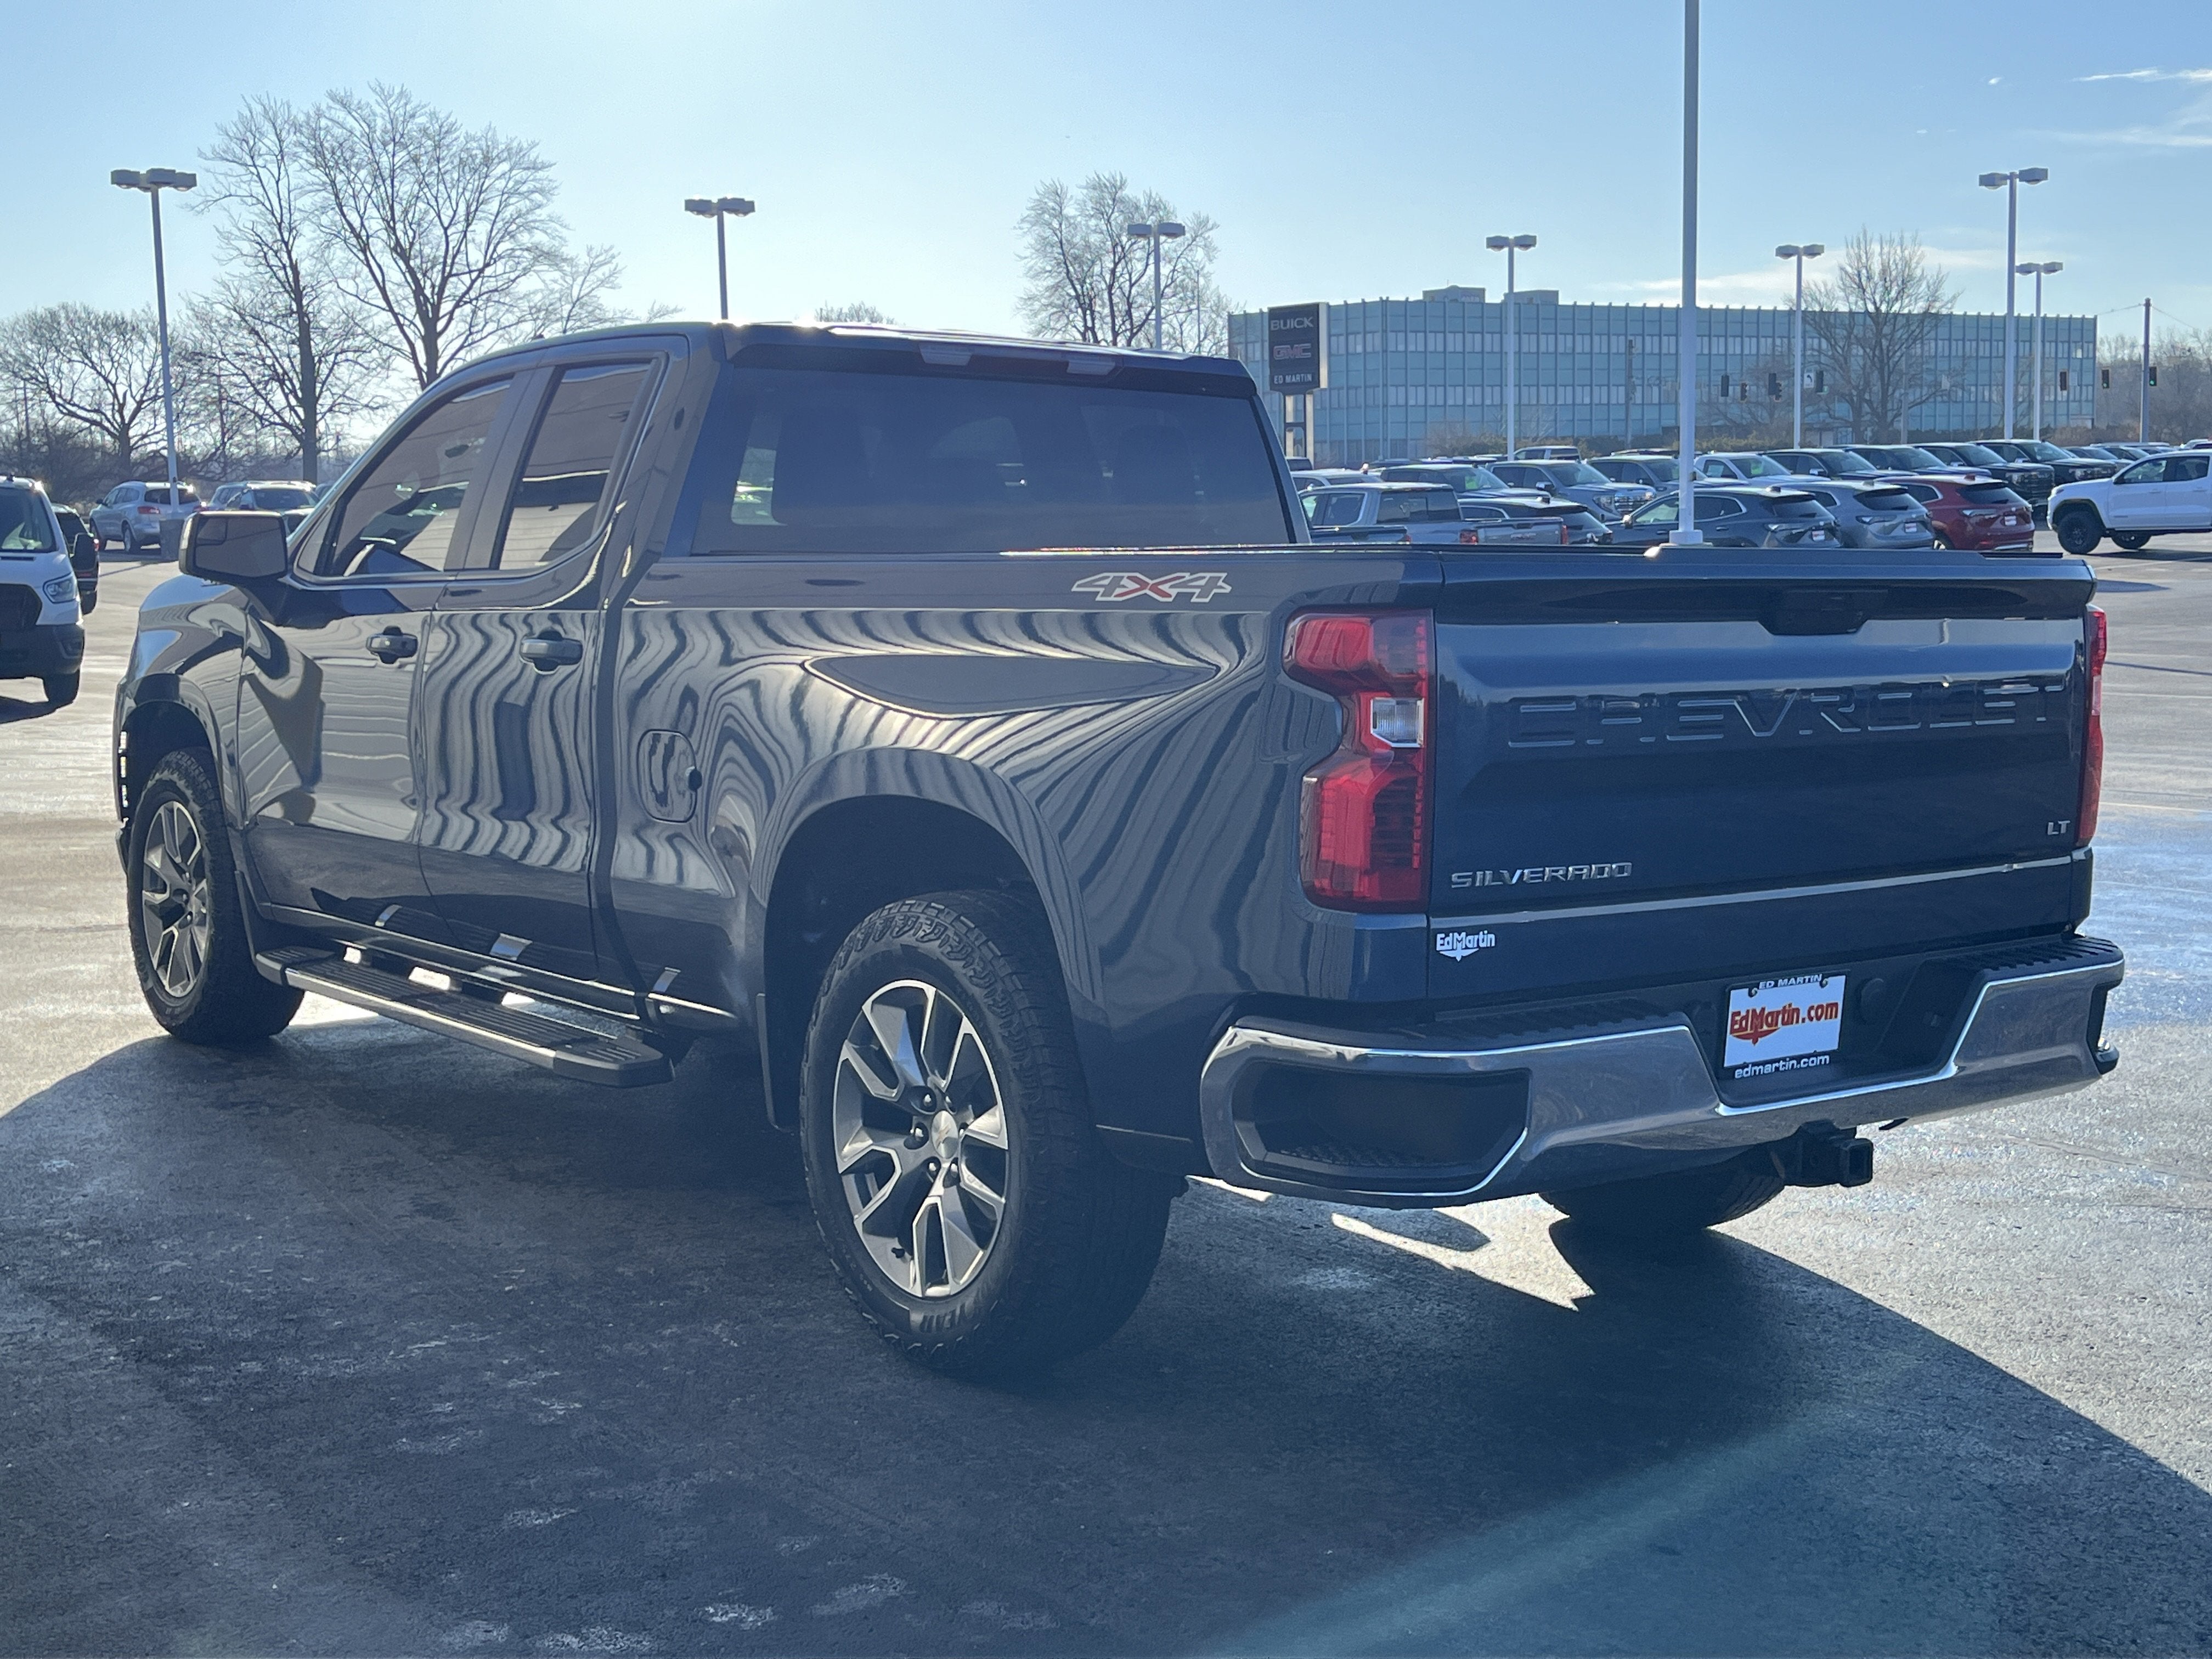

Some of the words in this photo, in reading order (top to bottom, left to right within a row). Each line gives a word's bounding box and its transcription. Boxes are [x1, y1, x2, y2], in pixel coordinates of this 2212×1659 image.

[1270, 317, 1314, 331] BUICK
[1273, 343, 1312, 360] GMC
[1274, 375, 1284, 384] ED
[1285, 374, 1312, 383] MARTIN
[2047, 820, 2071, 836] LT
[1451, 862, 1633, 889] SILVERADO
[1759, 981, 1775, 989] ED
[1778, 974, 1822, 987] MARTIN
[1734, 1054, 1830, 1079] edmartin.com
